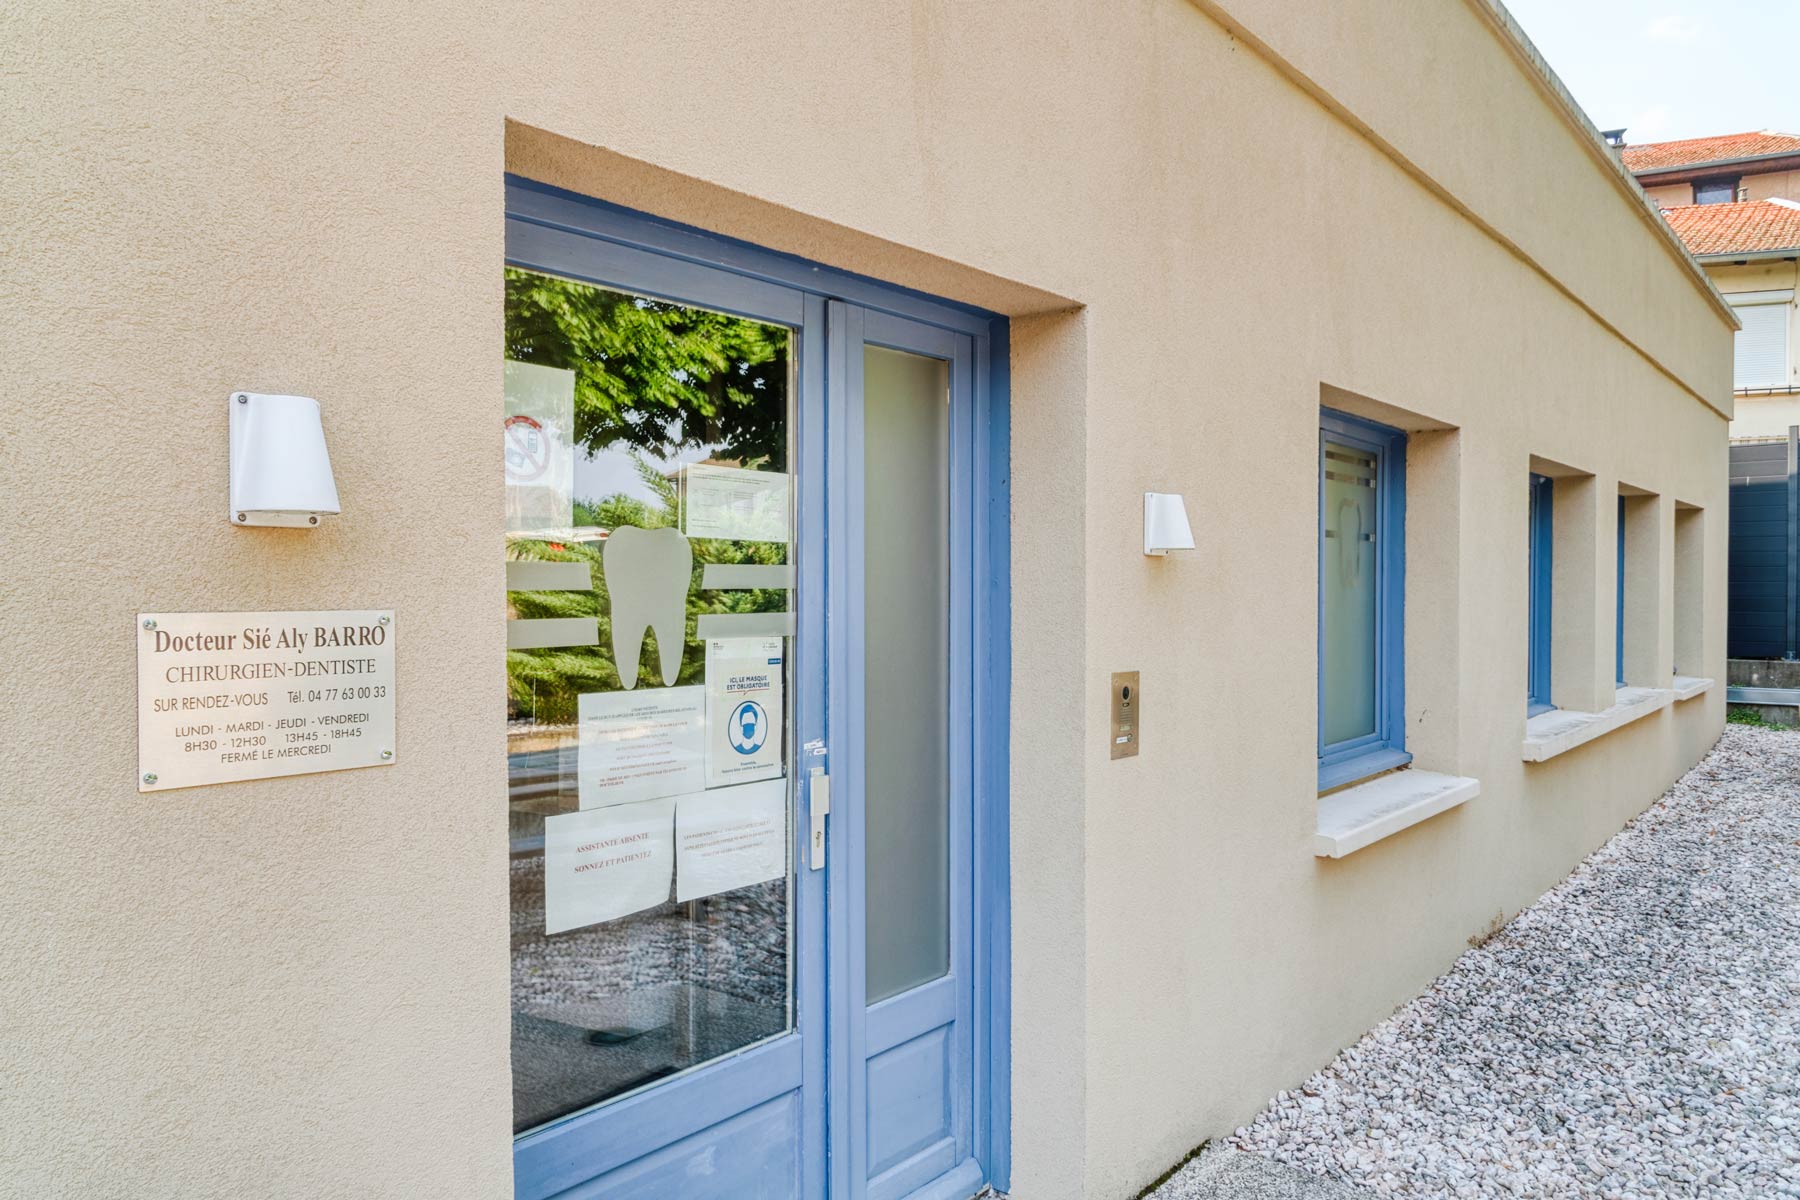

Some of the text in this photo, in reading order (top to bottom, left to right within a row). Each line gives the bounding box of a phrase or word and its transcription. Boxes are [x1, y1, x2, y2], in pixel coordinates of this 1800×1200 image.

[155, 625, 386, 653] Docteur Sié Aly BARRO
[166, 659, 376, 684] CHIRURGIEN-DENTISTE
[154, 693, 269, 712] SUR RENDEZ-VOUS
[288, 686, 386, 703] Tél. 04 77 63 00 33
[175, 724, 214, 737] LUNDI
[226, 722, 264, 733] MARDI
[275, 718, 306, 730] JEUDI
[318, 713, 369, 726] VENDREDI
[184, 740, 217, 752] 8H30
[231, 736, 266, 748] 12H30
[285, 732, 318, 743] 13H45
[330, 728, 362, 739] 18H45
[262, 749, 274, 760] LE
[277, 744, 331, 758] MERCREDI
[576, 832, 650, 853] ASSISTANTE ABSENTE
[574, 861, 604, 873] SONNEZ
[616, 851, 652, 864] PATIENTEZ
